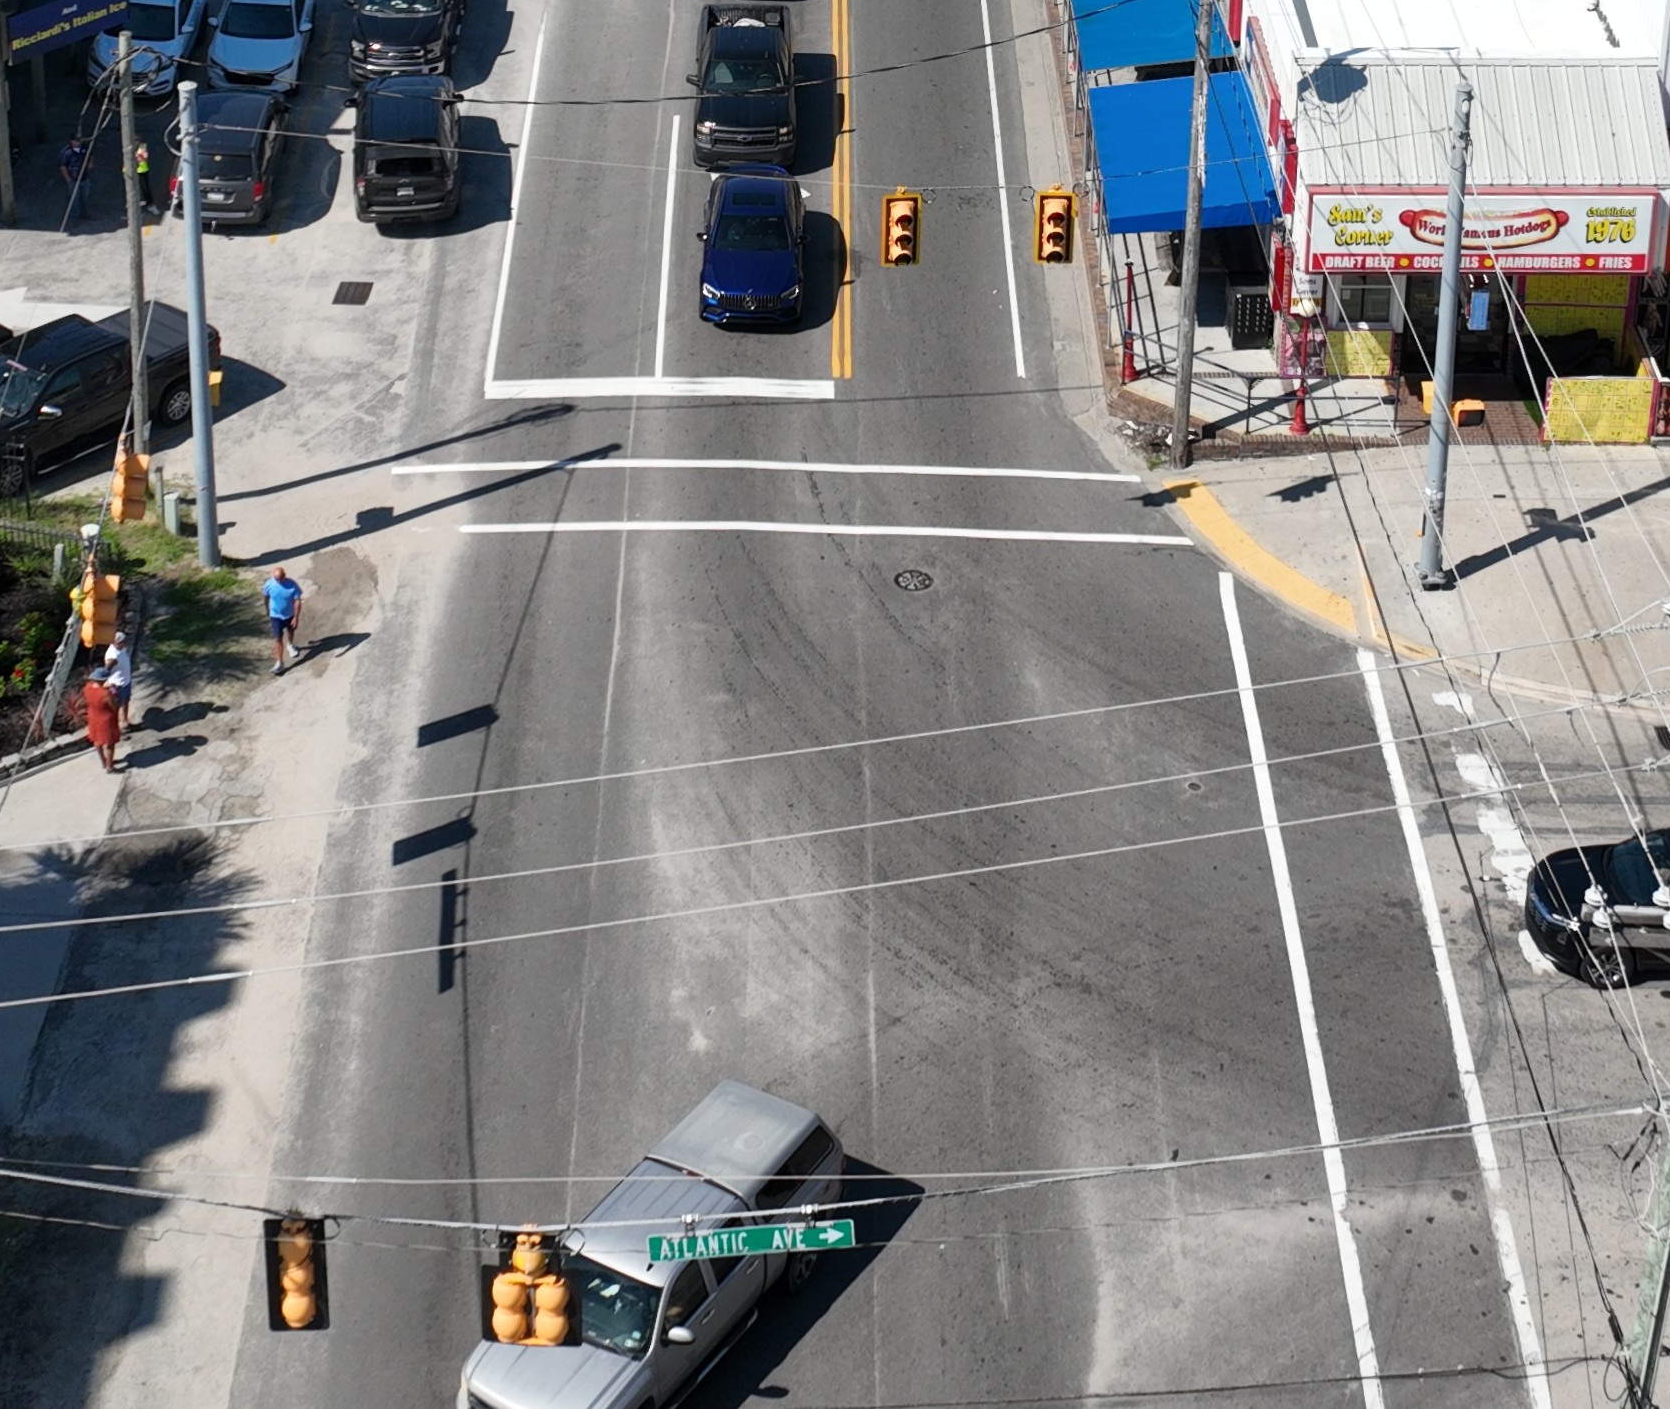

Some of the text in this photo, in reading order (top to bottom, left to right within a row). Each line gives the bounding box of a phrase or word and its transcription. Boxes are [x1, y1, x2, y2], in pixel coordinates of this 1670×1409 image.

[73, 8, 108, 28] Italian
[109, 1, 127, 13] Ice
[1328, 203, 1382, 224] Sam's
[1335, 225, 1394, 247] Corner
[1419, 219, 1447, 236] Worl
[1585, 218, 1636, 245] 1976
[1325, 256, 1395, 268] DRAFT BEER
[1497, 257, 1580, 269] HAMBURGERS
[1598, 256, 1632, 269] FRIES
[659, 1228, 807, 1261] ATLANTIC AVE
